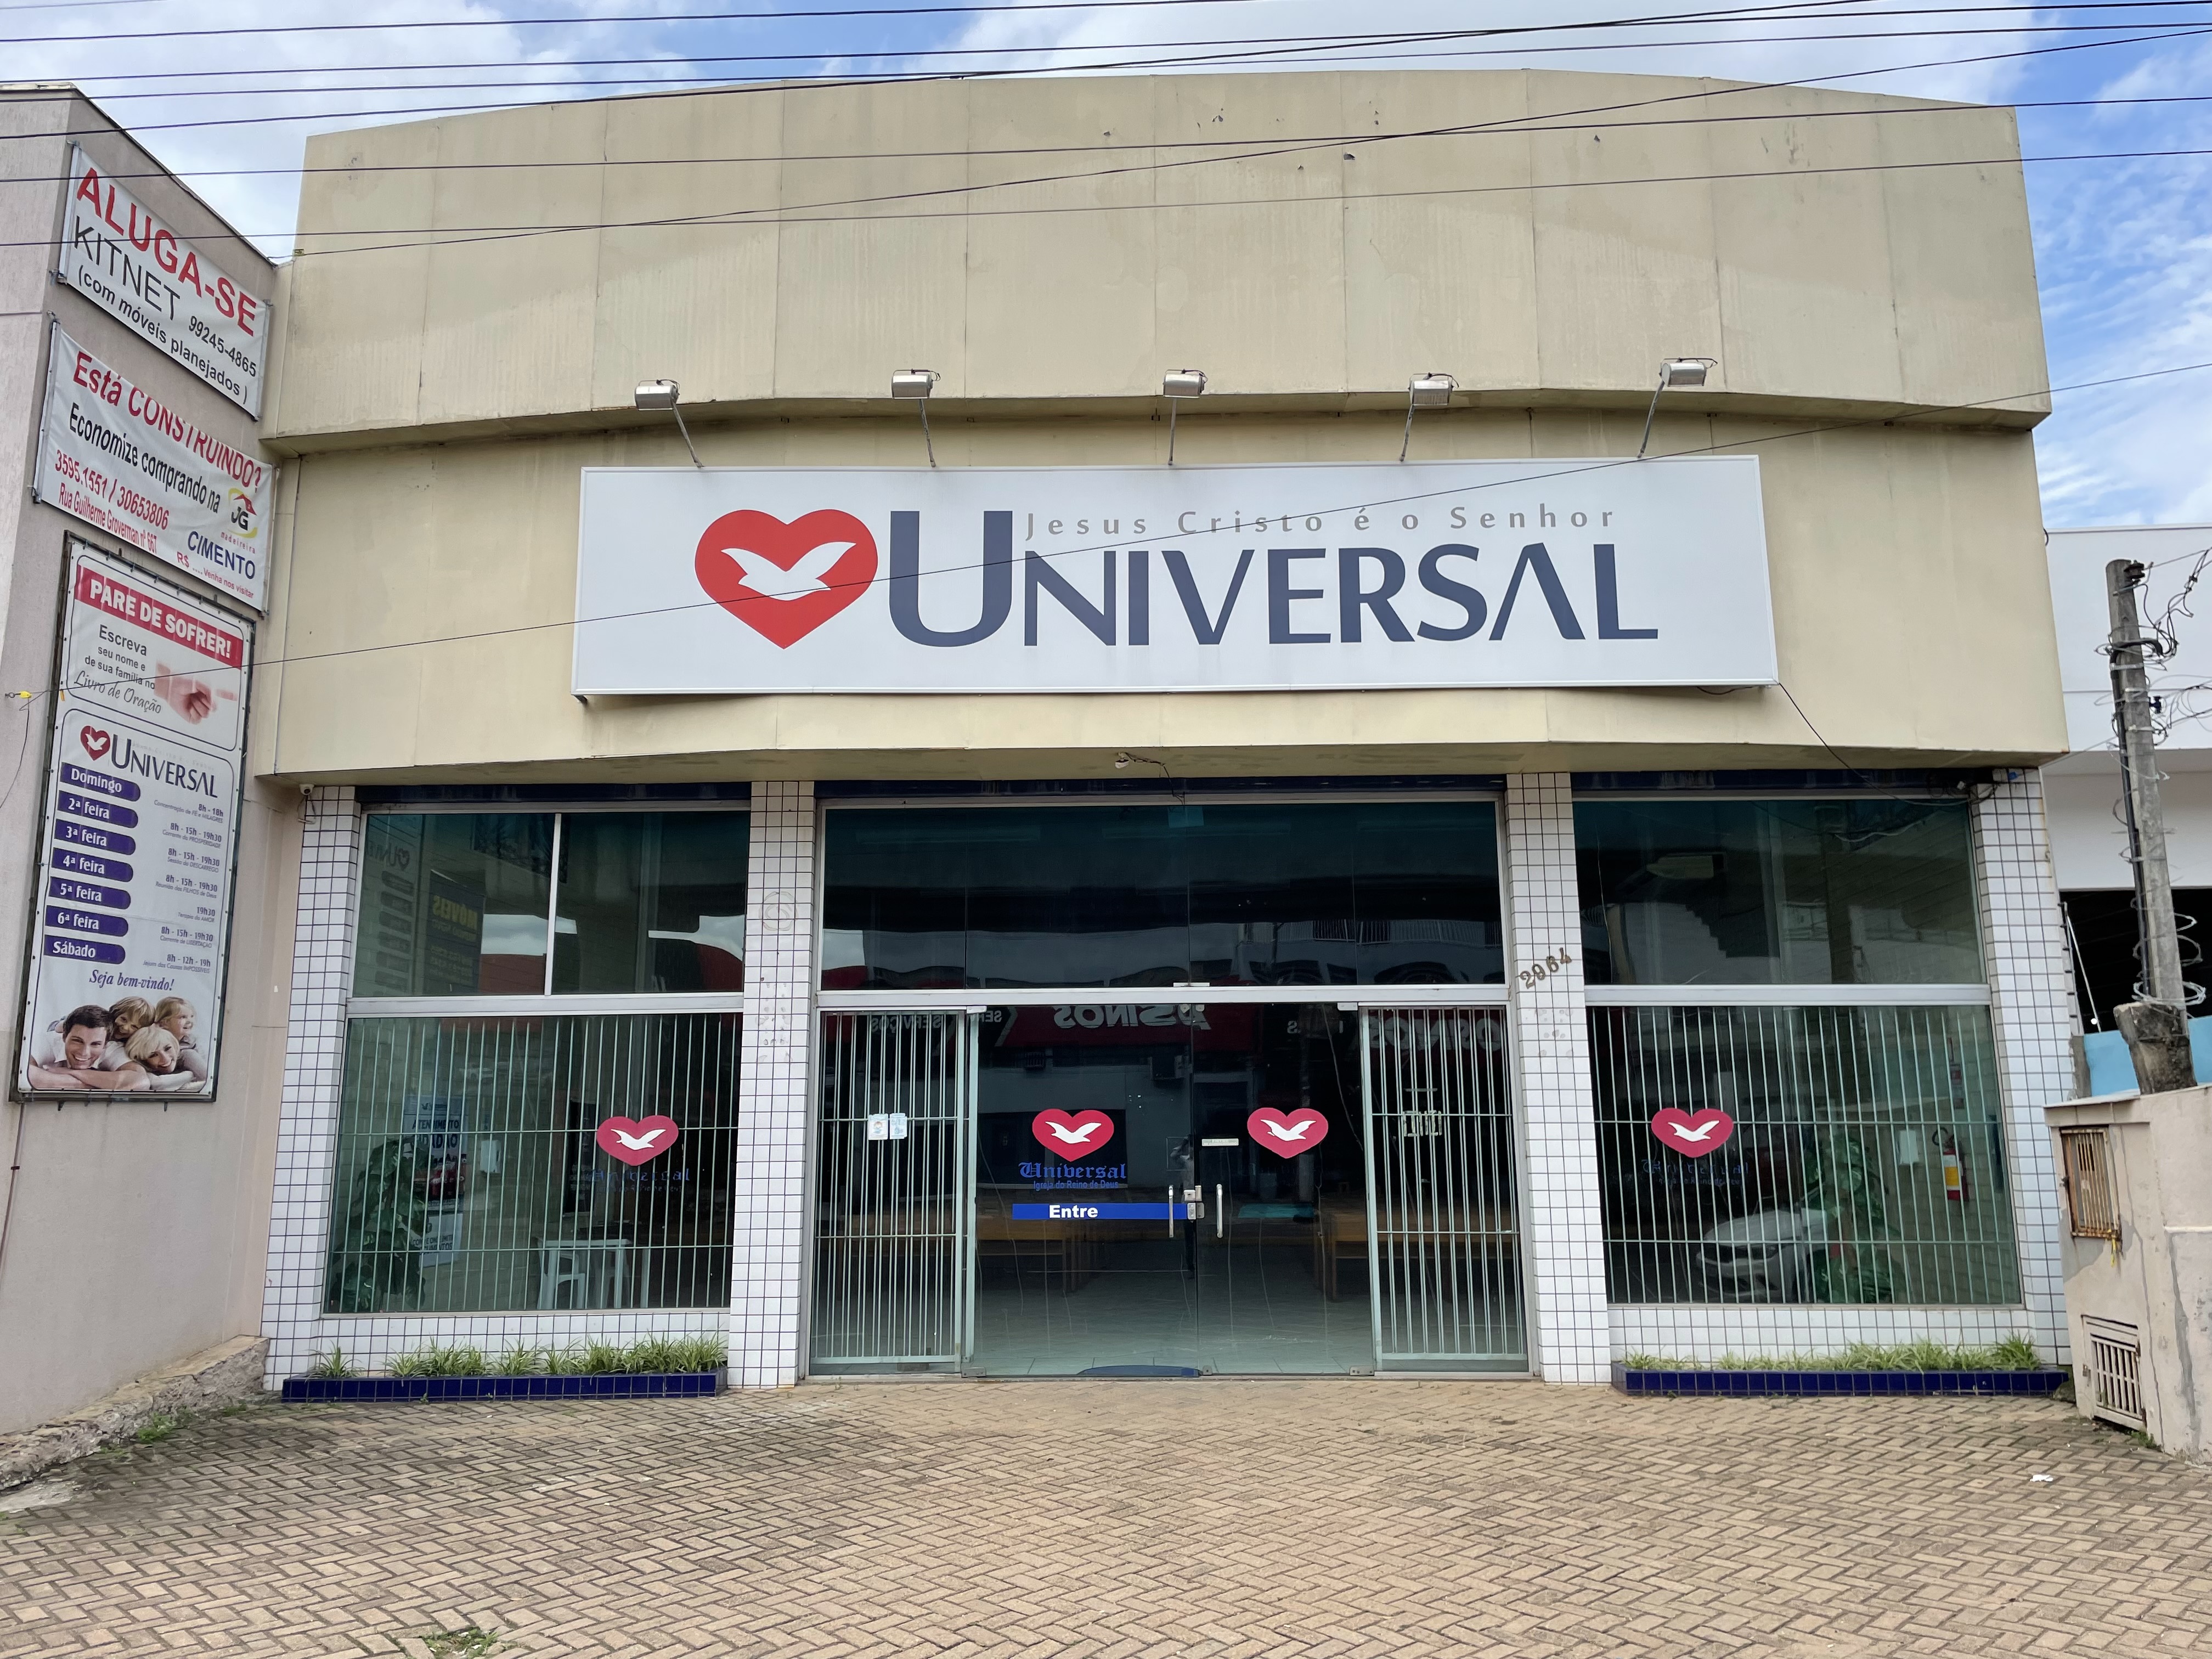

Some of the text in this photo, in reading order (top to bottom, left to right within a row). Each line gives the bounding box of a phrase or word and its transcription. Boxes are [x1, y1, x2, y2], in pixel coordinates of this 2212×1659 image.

[77, 167, 257, 337] ALUGA-SE
[74, 216, 180, 320] KITNET
[78, 266, 115, 304] (com
[119, 298, 166, 343] móveis
[171, 338, 240, 396] planejados
[189, 315, 256, 377] 99245-4865
[72, 351, 262, 493] Está CONSTRUINDO?
[70, 403, 221, 514] Economize comprando na
[55, 449, 108, 499] 3595.1551
[117, 486, 169, 530] 30653806
[59, 482, 72, 509] Rua
[74, 491, 106, 527] Guilherme
[148, 532, 157, 554] 667
[231, 506, 249, 531] JG
[1025, 503, 1614, 540] Jesus Cristo é o Senhor
[188, 531, 255, 579] CIMENTO
[221, 532, 256, 554] madeireira
[177, 551, 189, 568] R$
[204, 567, 222, 584] Venha
[224, 580, 234, 590] nos
[889, 510, 1658, 648] UNIVERSAL
[90, 579, 231, 658] PARE DE SOFRER!
[99, 624, 146, 656] Escreva
[98, 646, 113, 659] seu
[115, 653, 138, 669] nome
[84, 656, 95, 667] de
[98, 662, 112, 674] sua
[145, 681, 155, 690] no
[74, 670, 161, 713] Livro de Oração
[111, 733, 218, 798] UNIVERSAL
[71, 768, 122, 793] Domingo
[84, 802, 110, 819] feira
[198, 804, 206, 812] 8h
[212, 808, 223, 816] 18h
[82, 830, 106, 847] feira
[171, 822, 179, 831] 8h
[185, 826, 197, 836] 15h
[204, 831, 222, 842] 19h30
[80, 857, 105, 874] feira
[168, 848, 177, 856] 8h
[184, 851, 195, 861] 15h
[201, 856, 220, 867] 19h30
[76, 885, 101, 902] feira
[166, 874, 174, 883] 8h
[181, 878, 192, 887] 15h
[199, 882, 218, 892] 19h30
[74, 914, 99, 930] feira
[196, 906, 216, 917] 19h30
[161, 926, 170, 934] 8h
[177, 929, 188, 938] 15h
[195, 932, 213, 941] 19h30
[53, 941, 95, 958] Sábado
[167, 954, 176, 962] 8h
[183, 956, 194, 965] 12h
[200, 959, 211, 967] 19h
[89, 969, 174, 991] Seja bem-vindo!
[1519, 947, 1572, 990] 2964
[1018, 1162, 1126, 1178] Universal
[1034, 1180, 1119, 1191] Igreja do Reino de Deus
[1049, 1204, 1098, 1218] Entre
